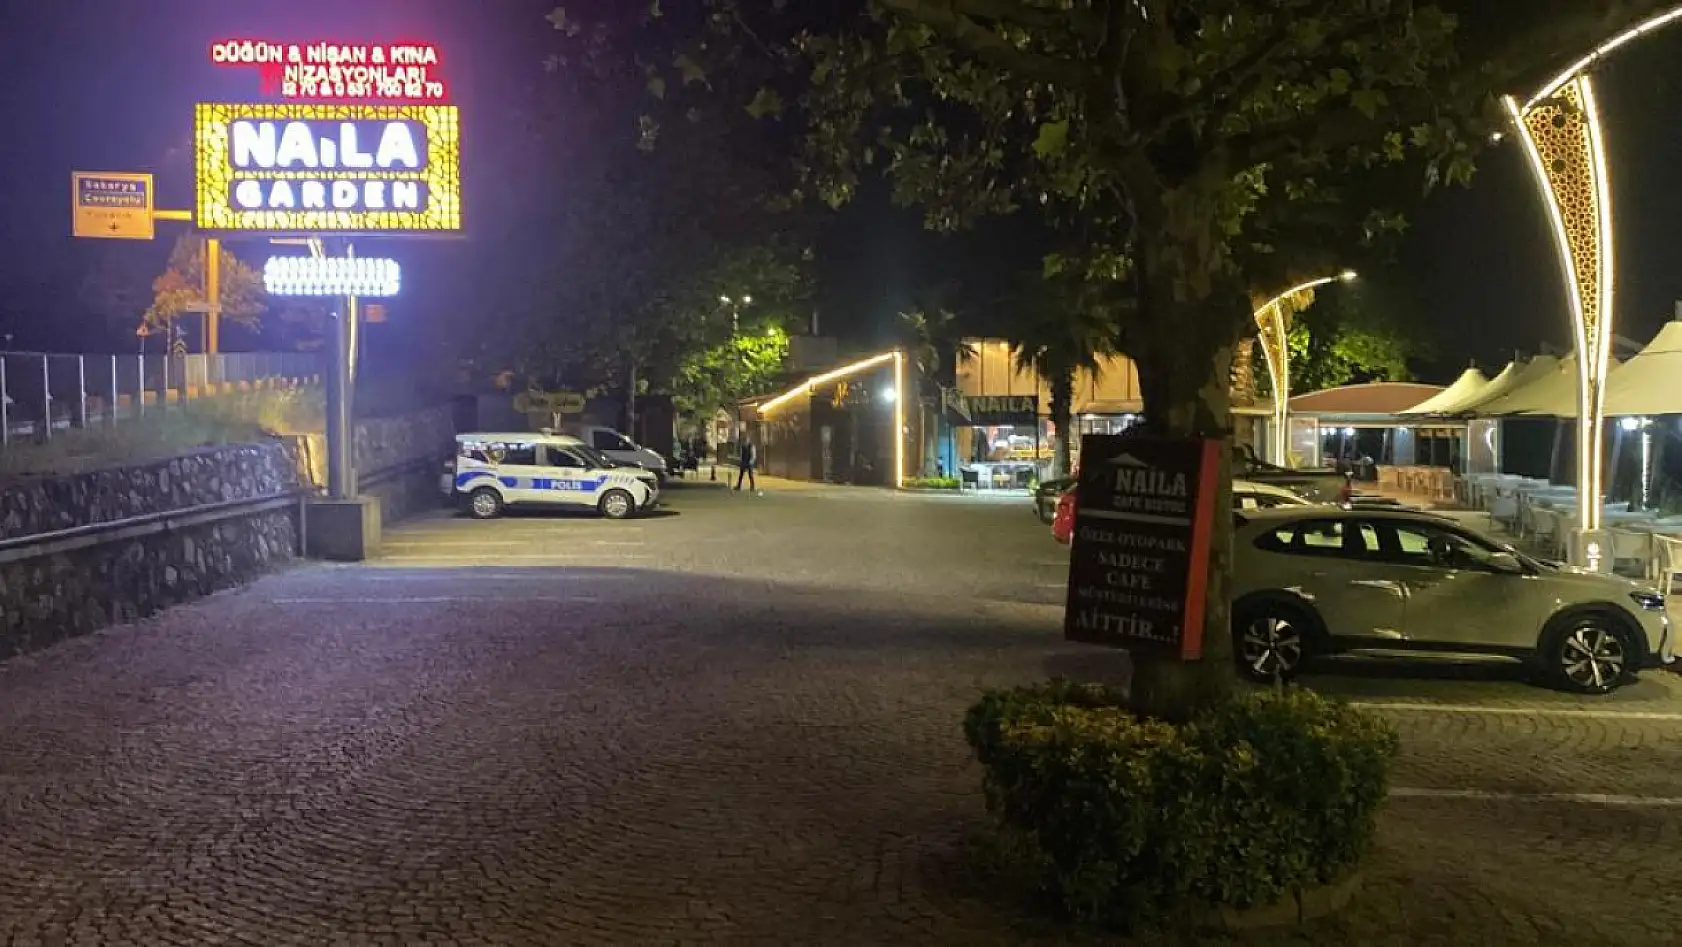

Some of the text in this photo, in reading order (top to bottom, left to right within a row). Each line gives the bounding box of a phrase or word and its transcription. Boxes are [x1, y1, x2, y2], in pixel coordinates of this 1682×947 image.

[288, 46, 300, 62] &
[371, 46, 385, 63] &
[235, 180, 419, 209] GARDEN
